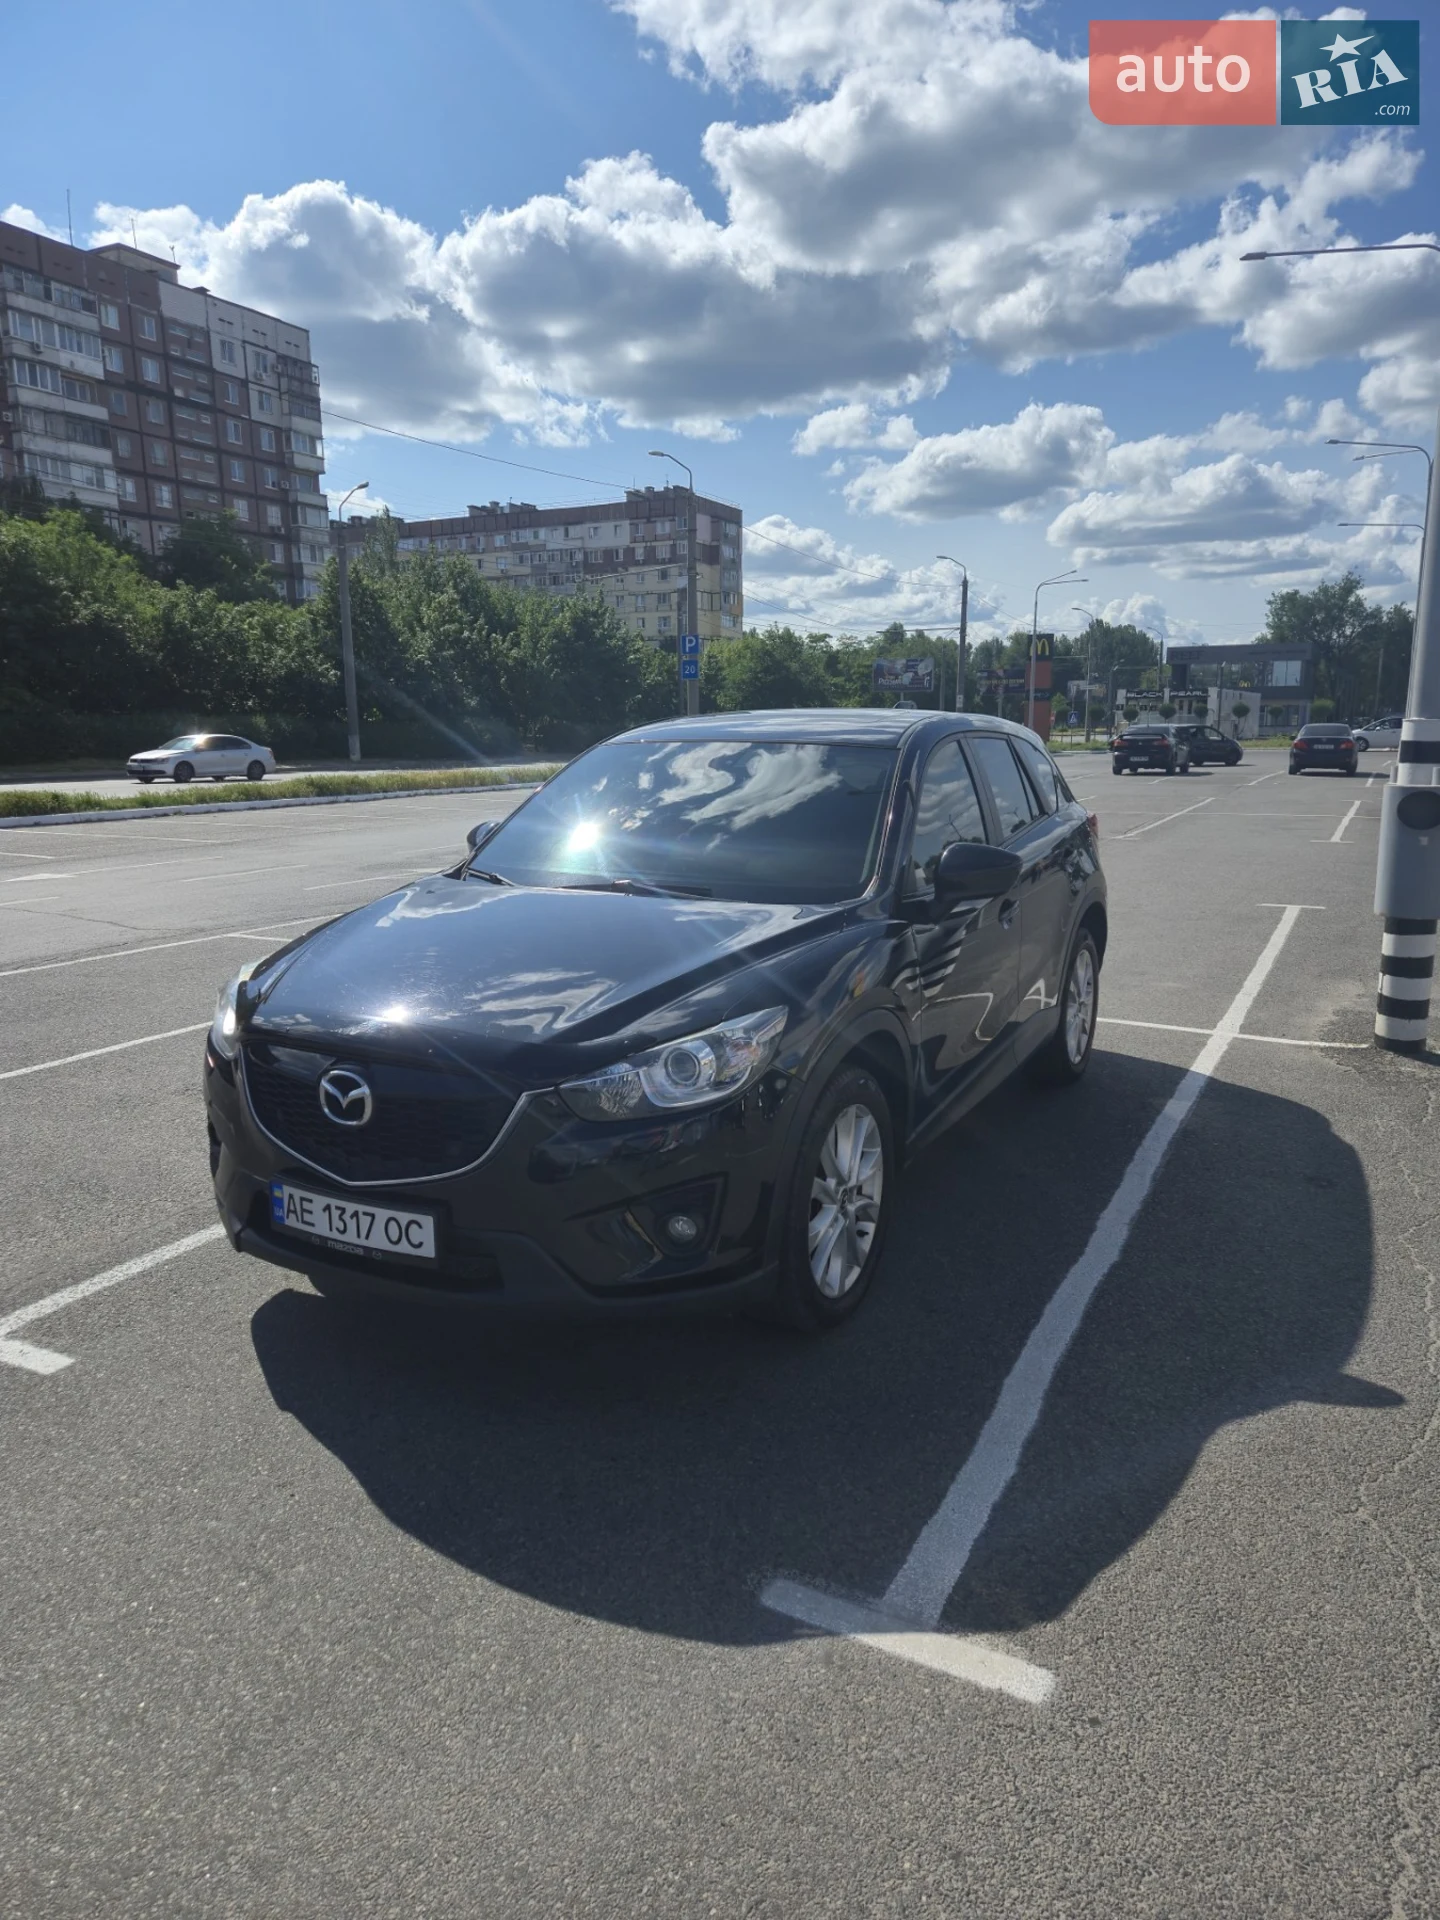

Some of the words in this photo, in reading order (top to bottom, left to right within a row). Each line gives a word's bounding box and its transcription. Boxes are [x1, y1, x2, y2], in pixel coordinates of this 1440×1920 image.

[685, 636, 696, 652] P
[684, 665, 696, 674] 20
[286, 1193, 315, 1226] AE
[322, 1203, 375, 1240] 1317
[384, 1216, 424, 1249] OC
